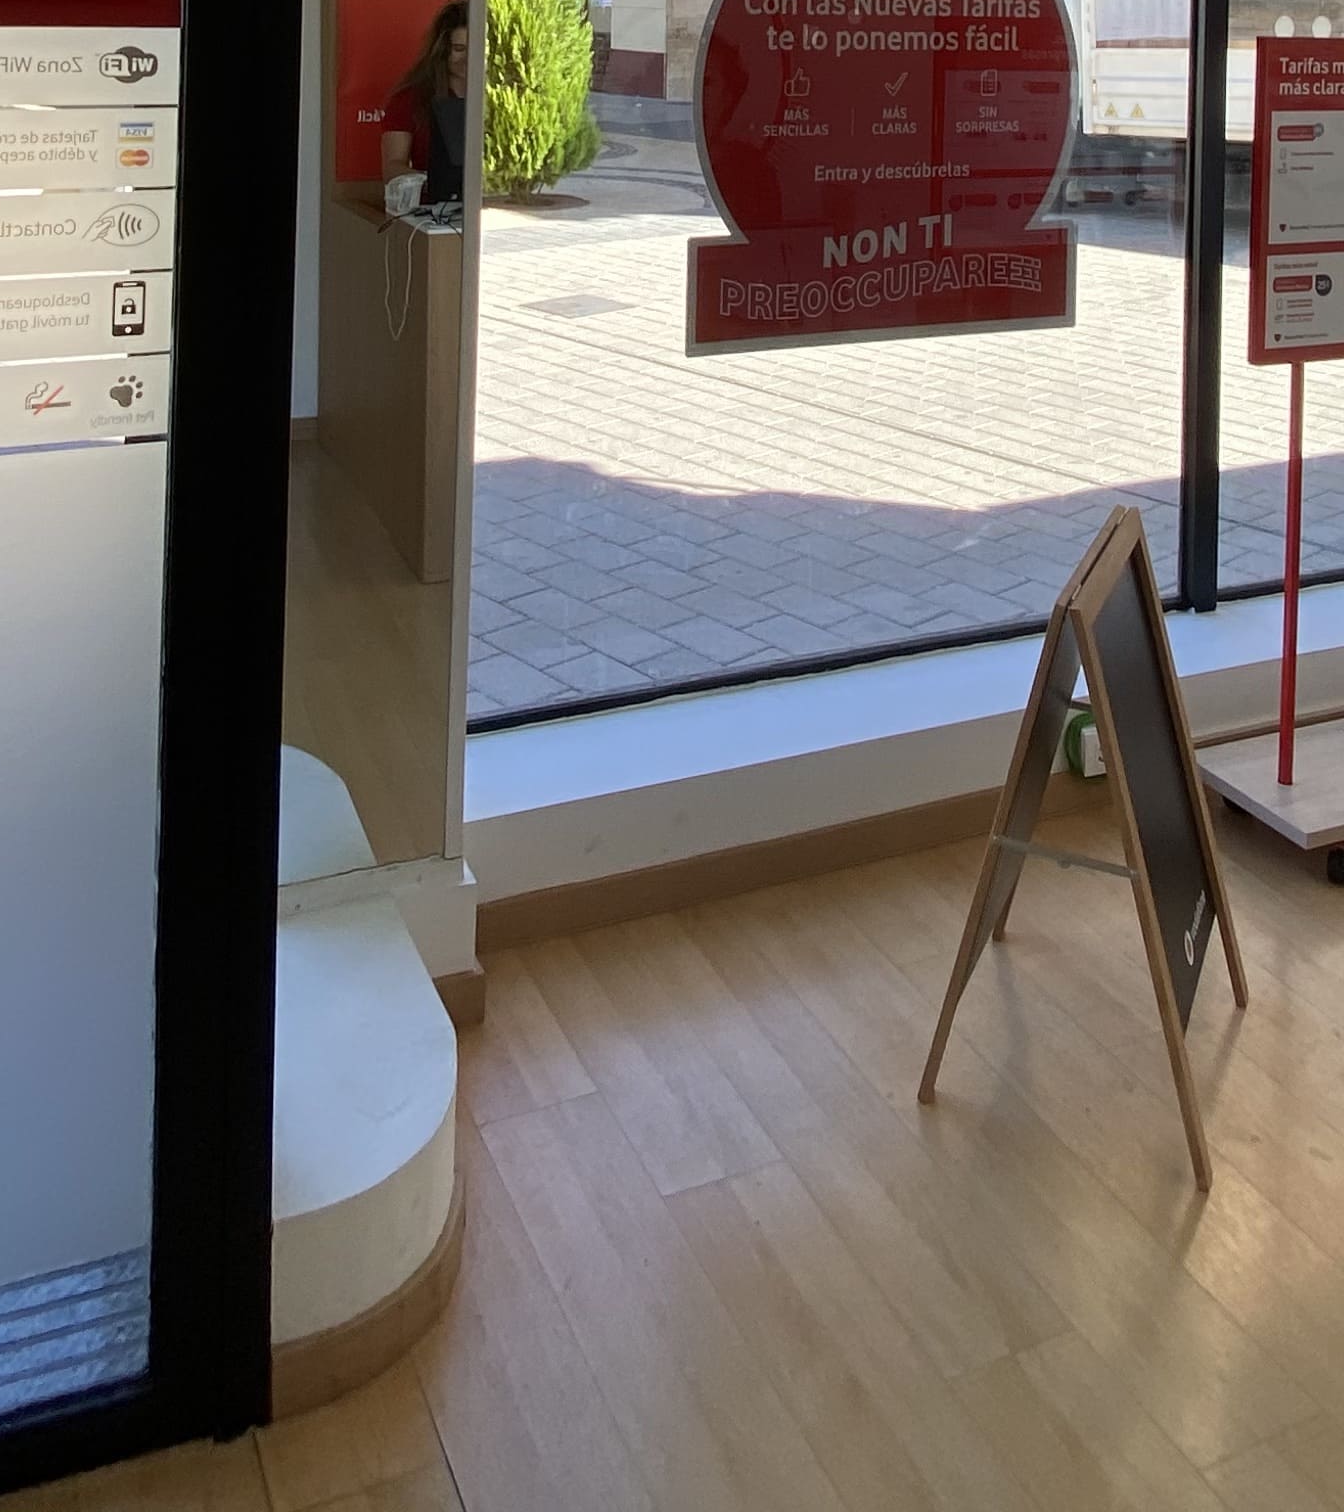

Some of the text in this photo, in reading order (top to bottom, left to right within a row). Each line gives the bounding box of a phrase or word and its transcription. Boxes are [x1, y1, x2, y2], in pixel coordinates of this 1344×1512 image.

[766, 24, 1019, 56] te lo ponemos fácil
[1280, 57, 1329, 74] Tarifas
[1279, 80, 1311, 95] más
[783, 105, 809, 121] MÁS
[882, 104, 907, 120] MÁS
[978, 106, 998, 119] SIN
[763, 122, 829, 137] SENCILLAS
[872, 122, 917, 135] CLARAS
[955, 120, 1020, 133] SORPRESAS
[814, 162, 970, 184] Entra y descúbrelas
[822, 215, 953, 269] NON TI
